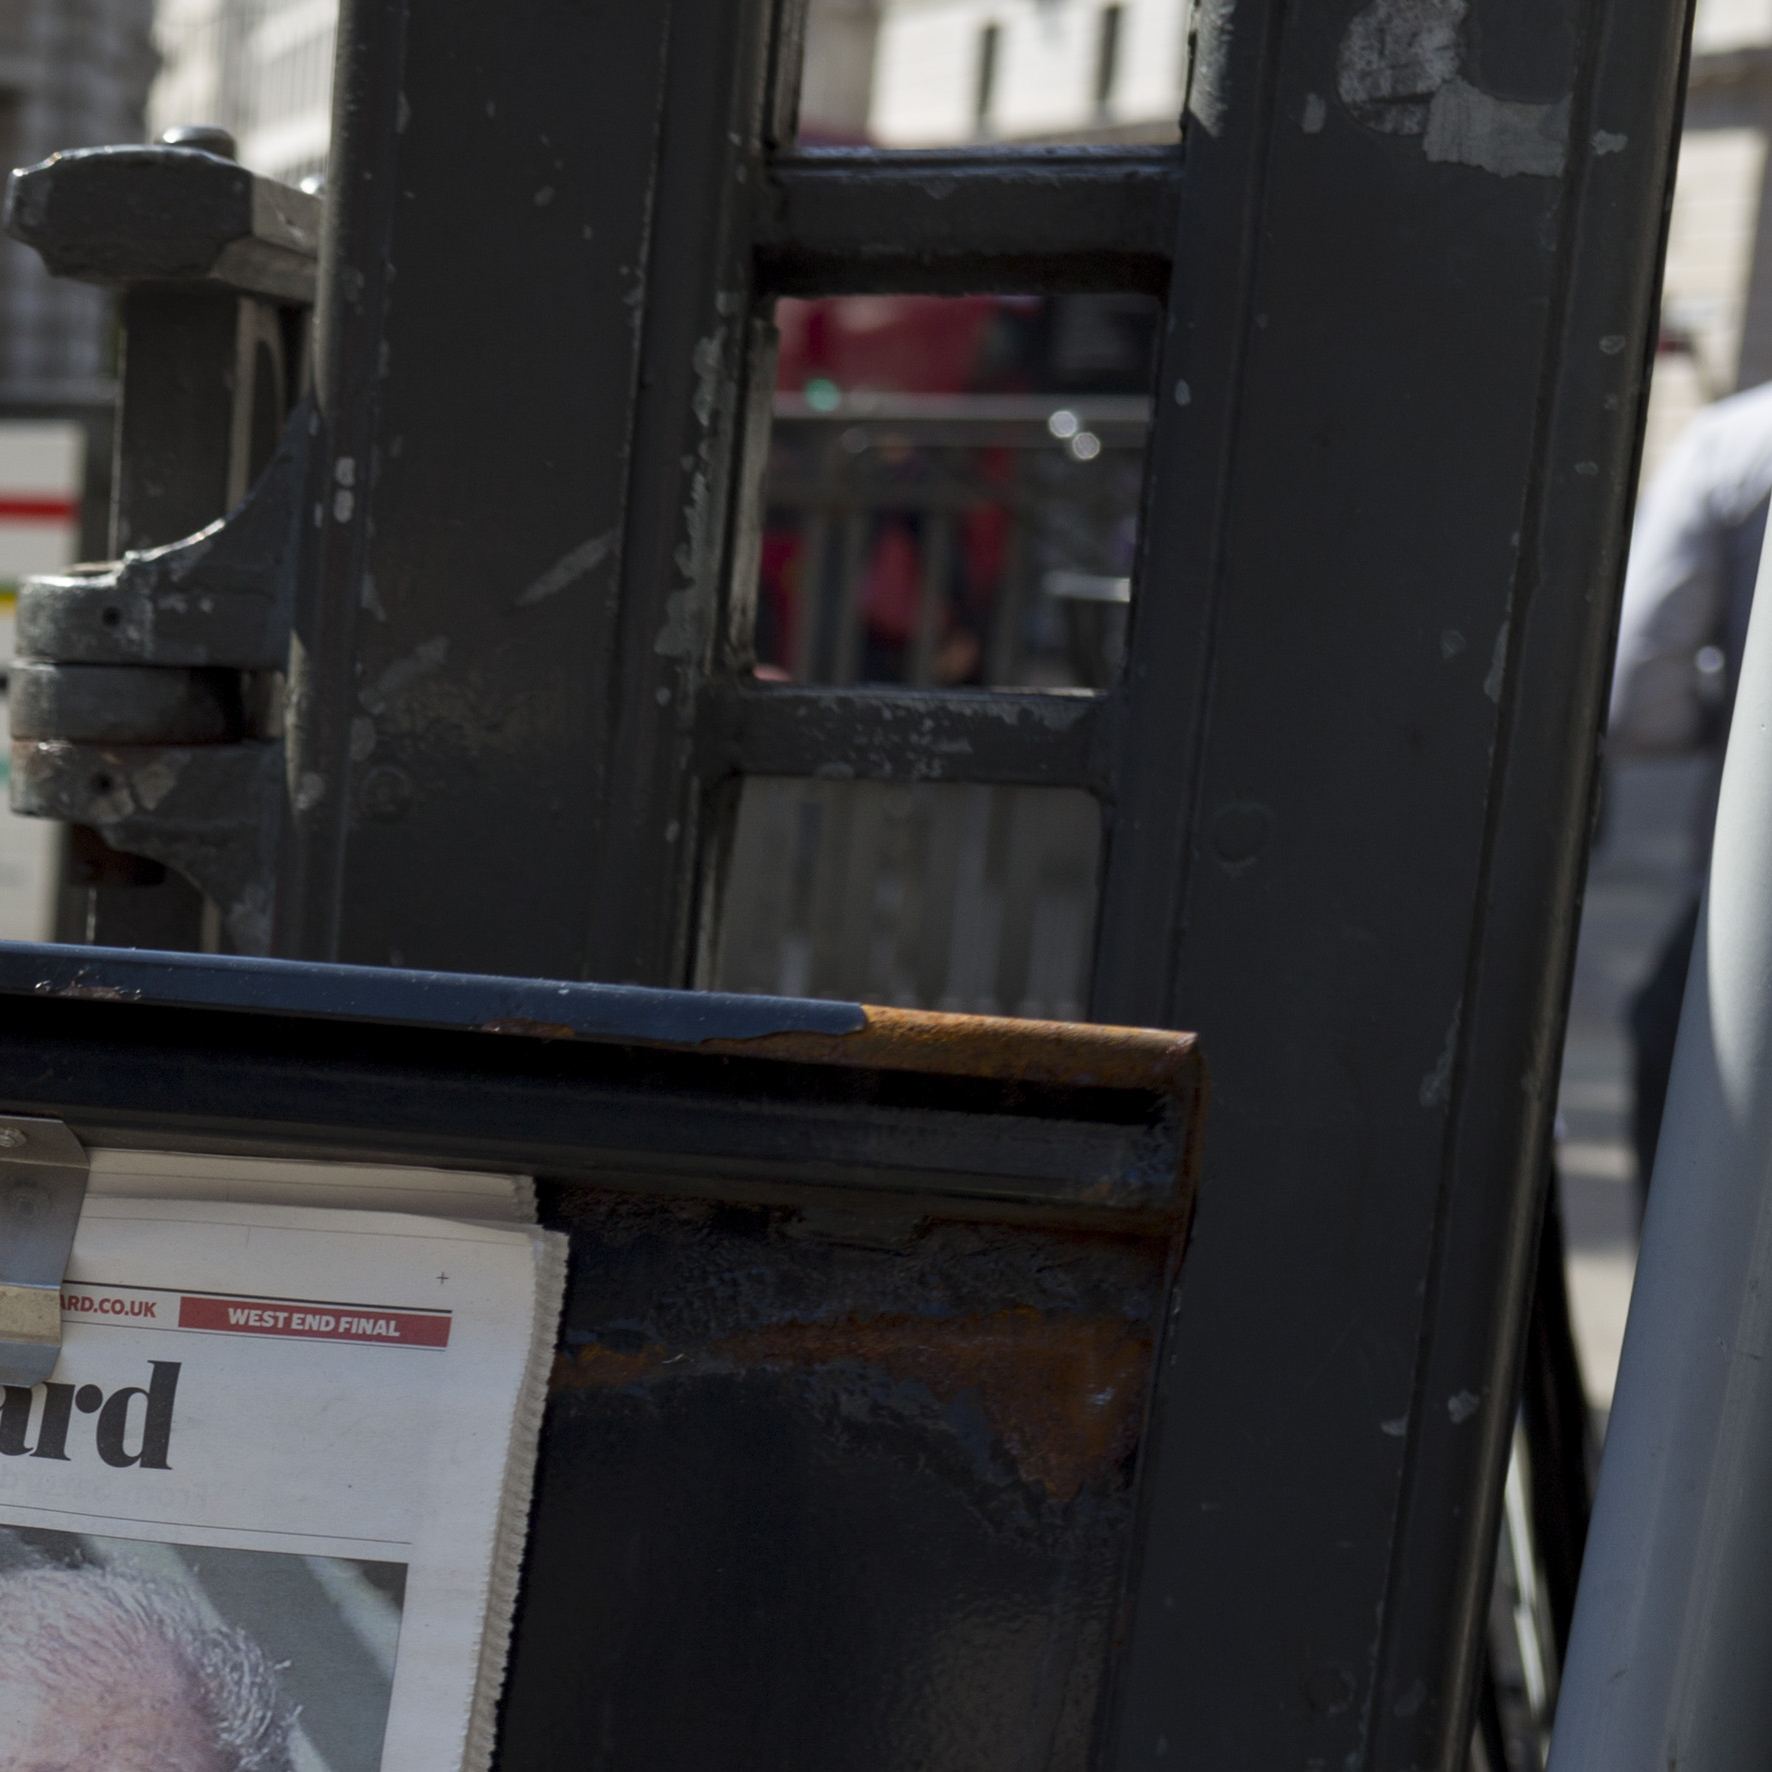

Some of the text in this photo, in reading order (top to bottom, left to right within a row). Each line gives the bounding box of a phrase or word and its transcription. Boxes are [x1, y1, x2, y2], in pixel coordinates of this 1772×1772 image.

[228, 1308, 400, 1336] WEST END FINAL
